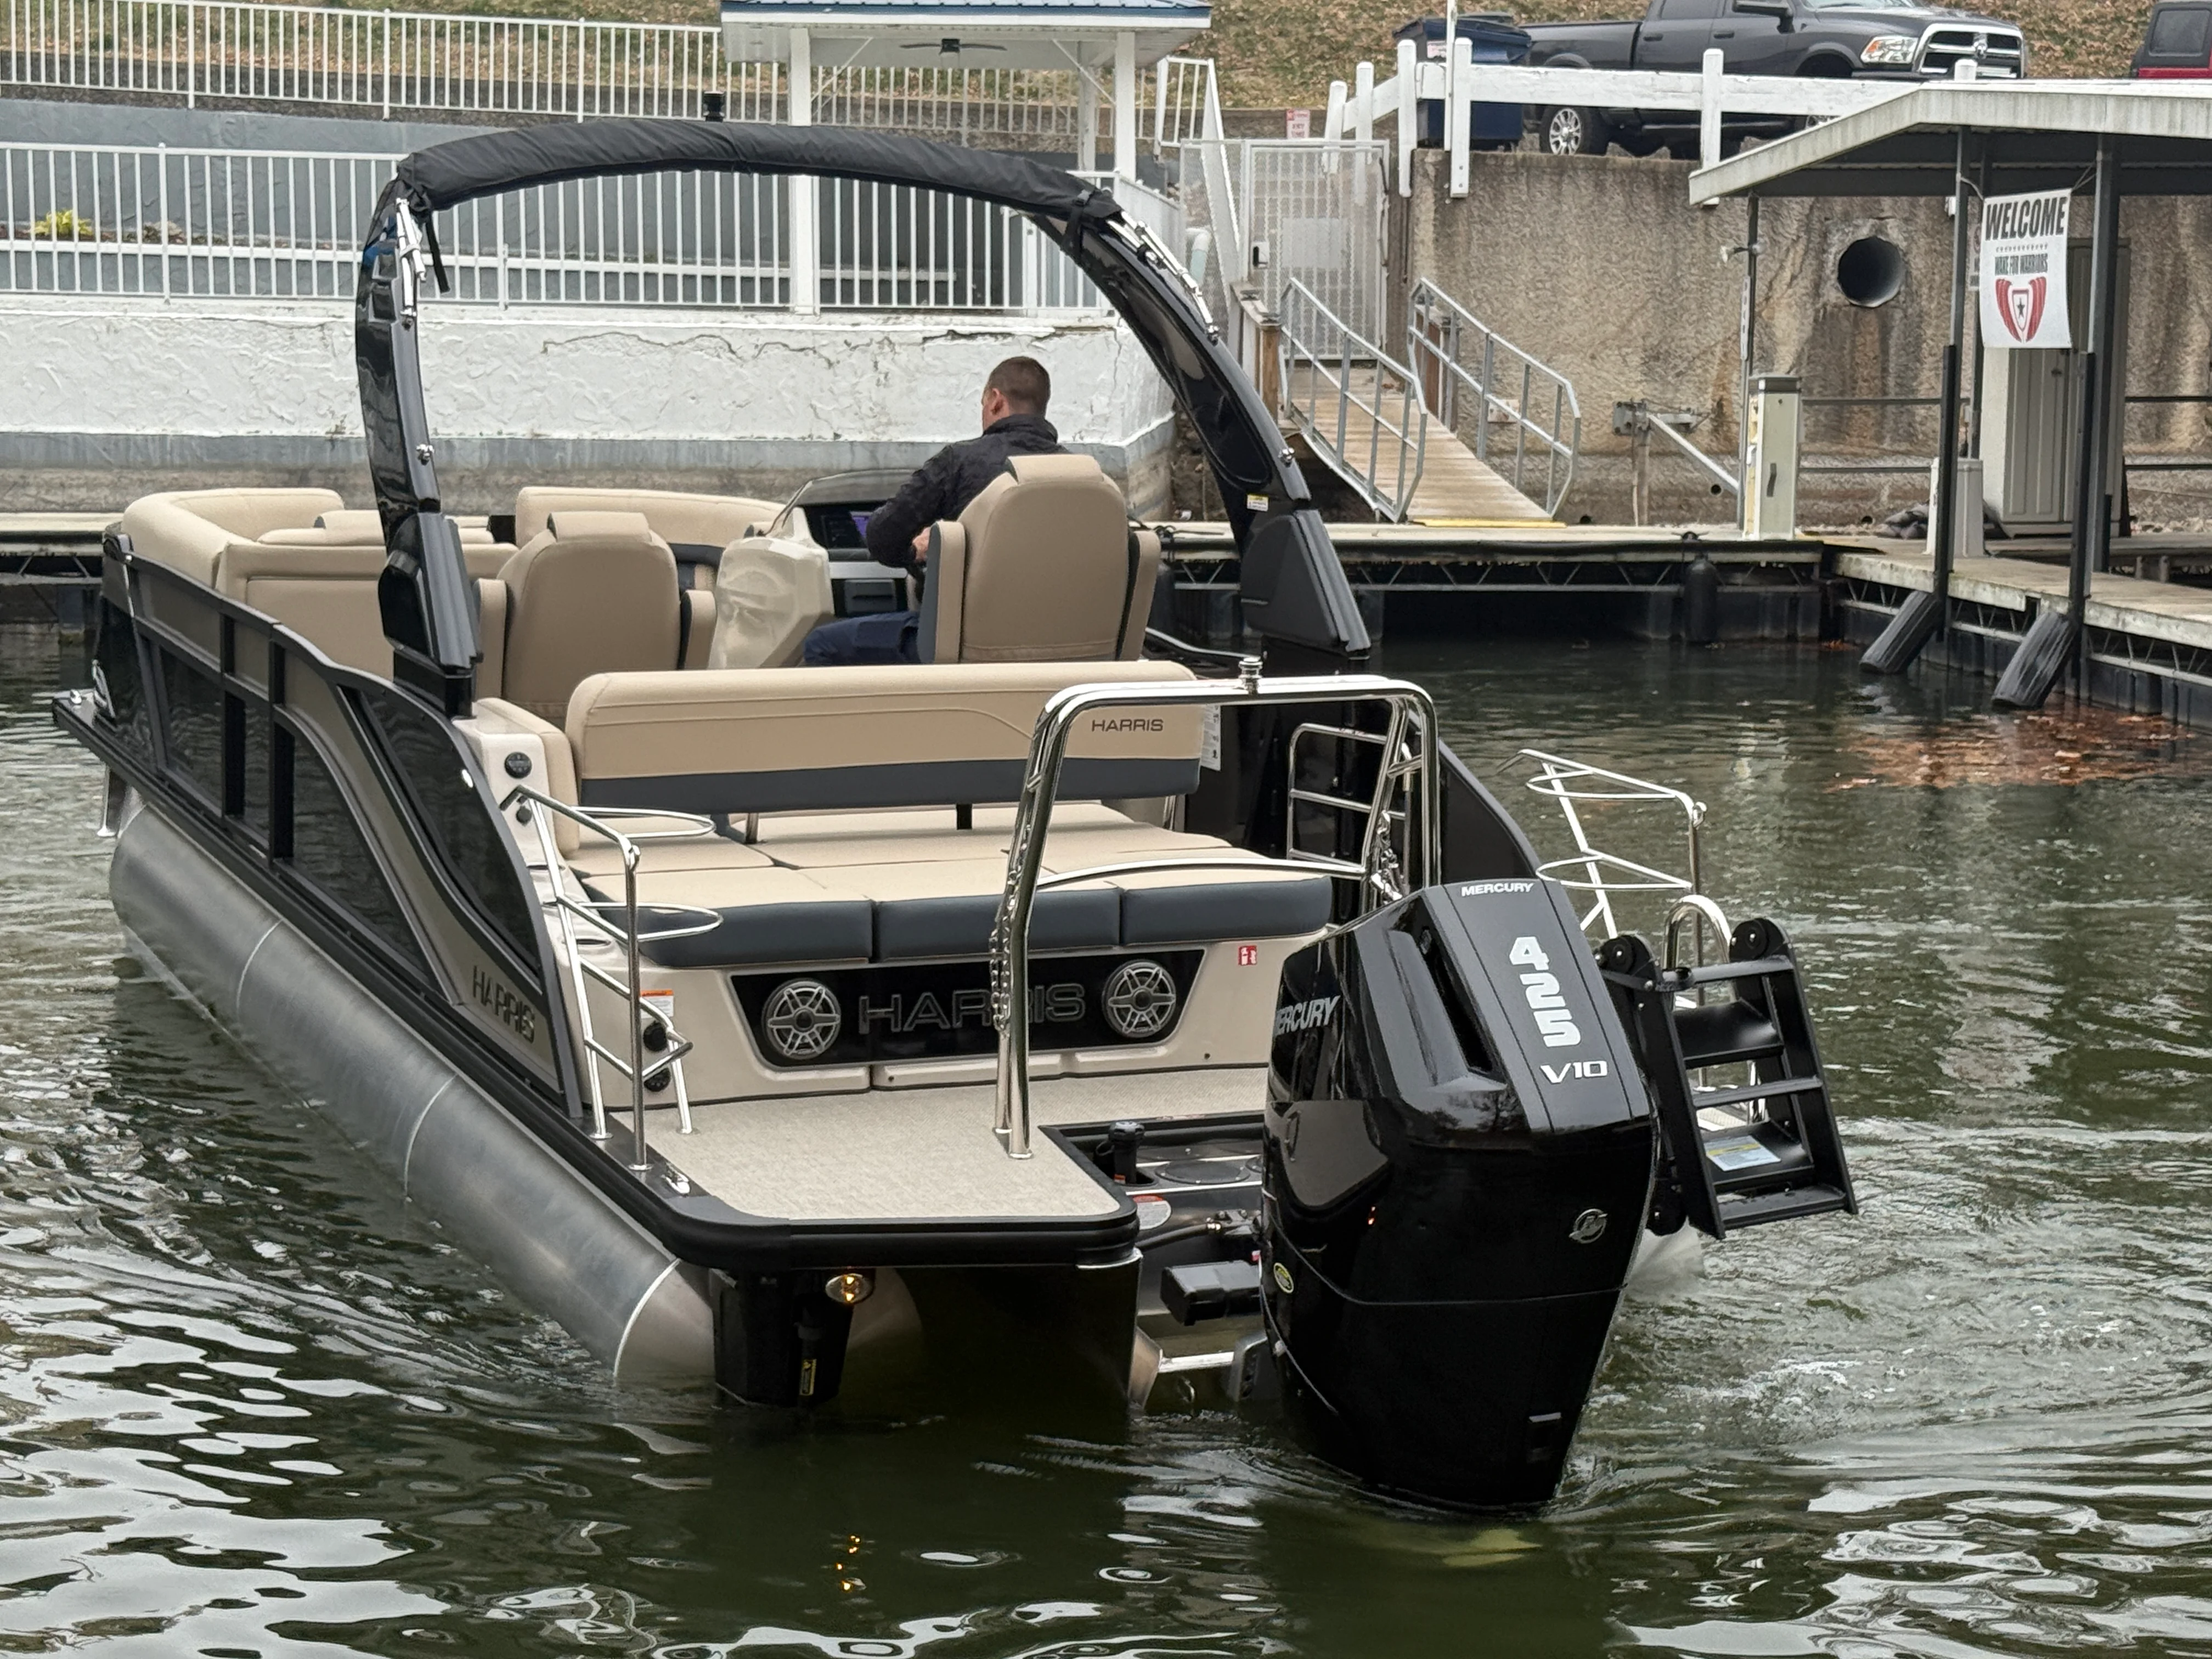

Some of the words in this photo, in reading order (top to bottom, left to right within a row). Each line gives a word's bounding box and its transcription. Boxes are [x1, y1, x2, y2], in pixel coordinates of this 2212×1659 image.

[1985, 197, 2068, 240] WELCOME
[1092, 719, 1164, 732] HARRIS
[1461, 882, 1534, 897] MERCURY
[473, 966, 535, 1043] HARRIS
[859, 983, 1086, 1035] HARIS
[1509, 936, 1581, 1047] 425
[1539, 1060, 1608, 1084] V10
